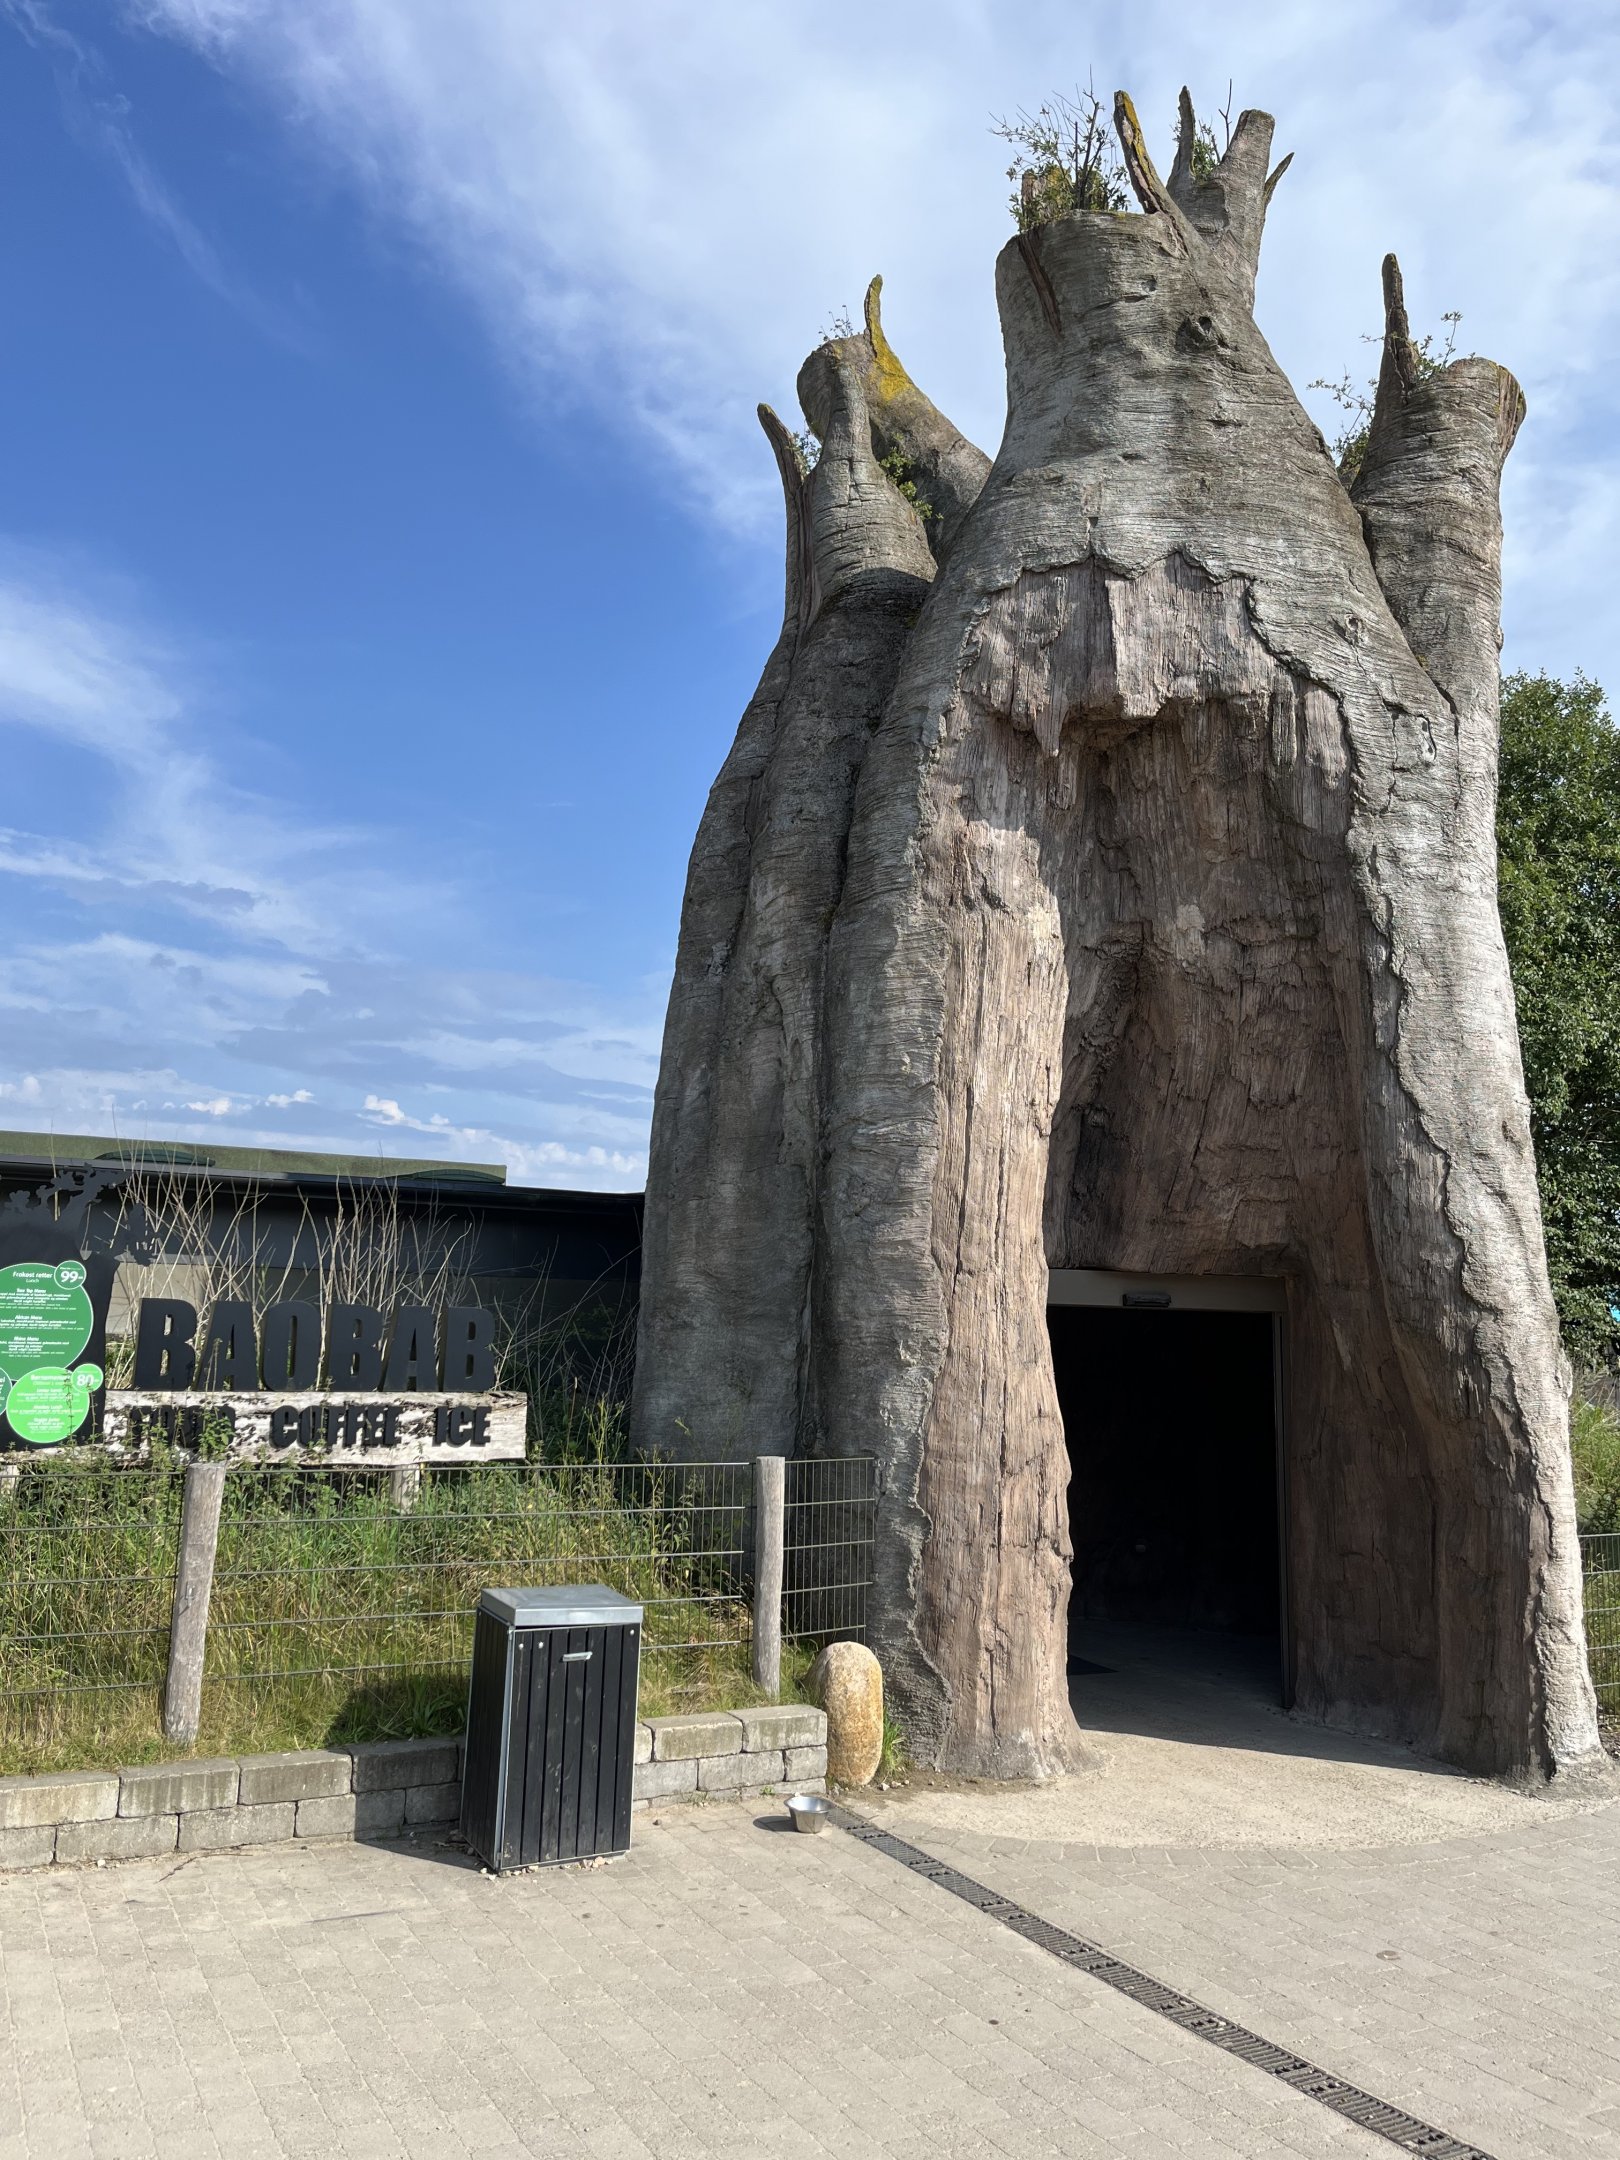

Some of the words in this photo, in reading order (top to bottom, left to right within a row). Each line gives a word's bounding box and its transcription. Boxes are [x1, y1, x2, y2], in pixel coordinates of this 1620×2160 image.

[134, 1297, 496, 1393] BAOBAB
[270, 1405, 403, 1448] COFFEE
[434, 1405, 492, 1446] ICE
